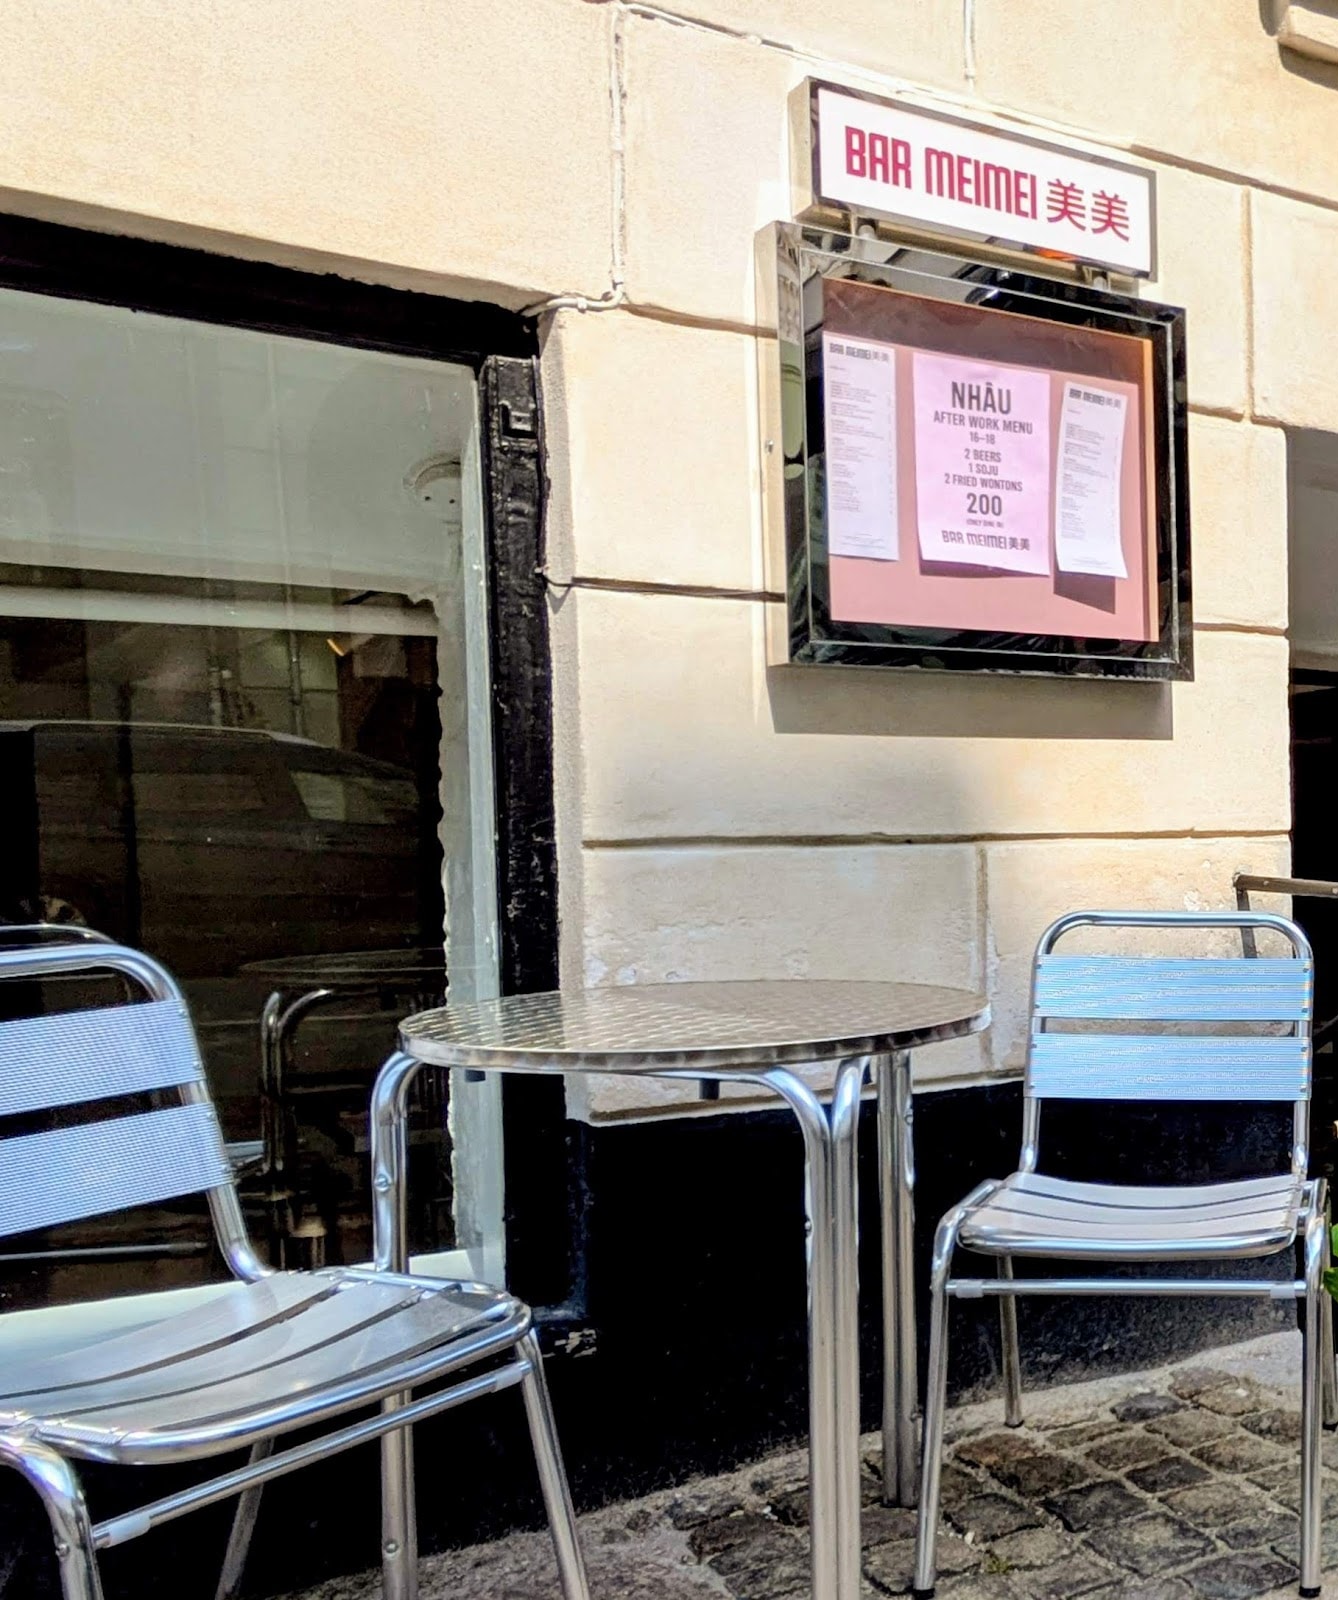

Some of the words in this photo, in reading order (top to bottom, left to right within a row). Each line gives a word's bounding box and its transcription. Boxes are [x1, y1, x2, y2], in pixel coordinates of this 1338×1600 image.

[844, 125, 912, 189] BAR
[925, 146, 1038, 220] MEIMEI
[1046, 178, 1130, 242] 美美
[933, 410, 966, 426] AFTER
[968, 415, 1000, 431] WORK
[1002, 420, 1033, 435] MENU
[964, 448, 971, 460] 2
[973, 449, 1002, 463] BEERS
[968, 462, 974, 473] 1
[975, 463, 999, 476] SOJU
[944, 473, 951, 485] 2
[952, 474, 978, 487] FRIED
[980, 477, 1023, 492] WONTONS
[966, 492, 1003, 517] 200
[941, 530, 965, 544] BAR
[966, 532, 1008, 550] MEIMEI
